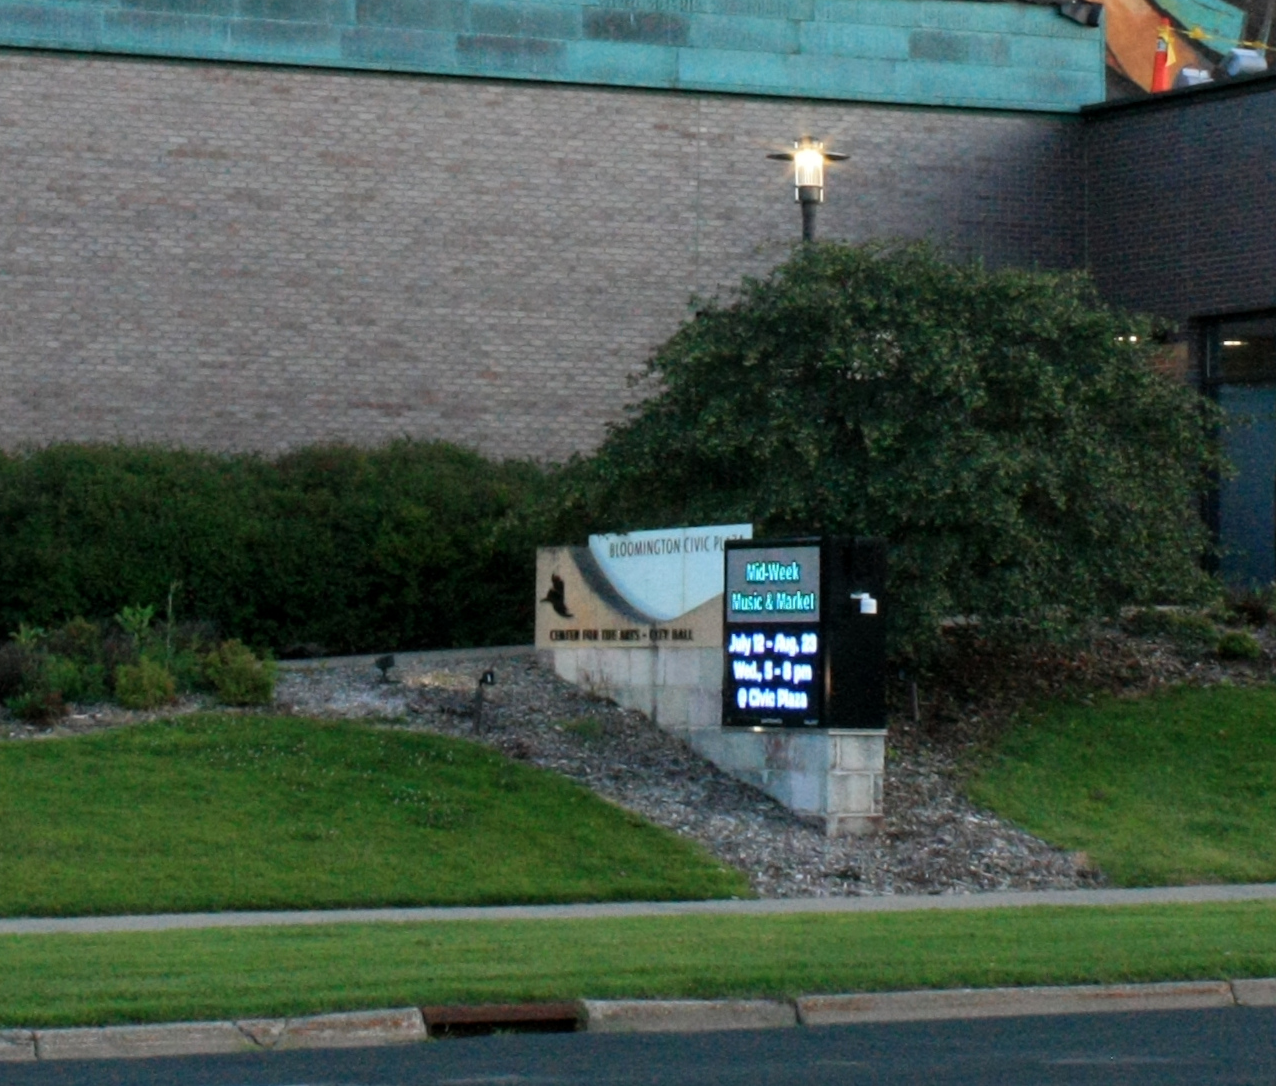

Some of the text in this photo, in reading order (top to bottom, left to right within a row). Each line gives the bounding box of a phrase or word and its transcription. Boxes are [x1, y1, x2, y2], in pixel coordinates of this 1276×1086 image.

[609, 538, 681, 558] BLOOMINGTON
[684, 536, 710, 553] CIVIC
[746, 561, 800, 581] Mid-Week
[731, 590, 815, 611] Music & Market
[728, 633, 752, 657] July
[793, 663, 813, 685] pm
[748, 687, 776, 708] Civic
[776, 687, 808, 710] Plaza
